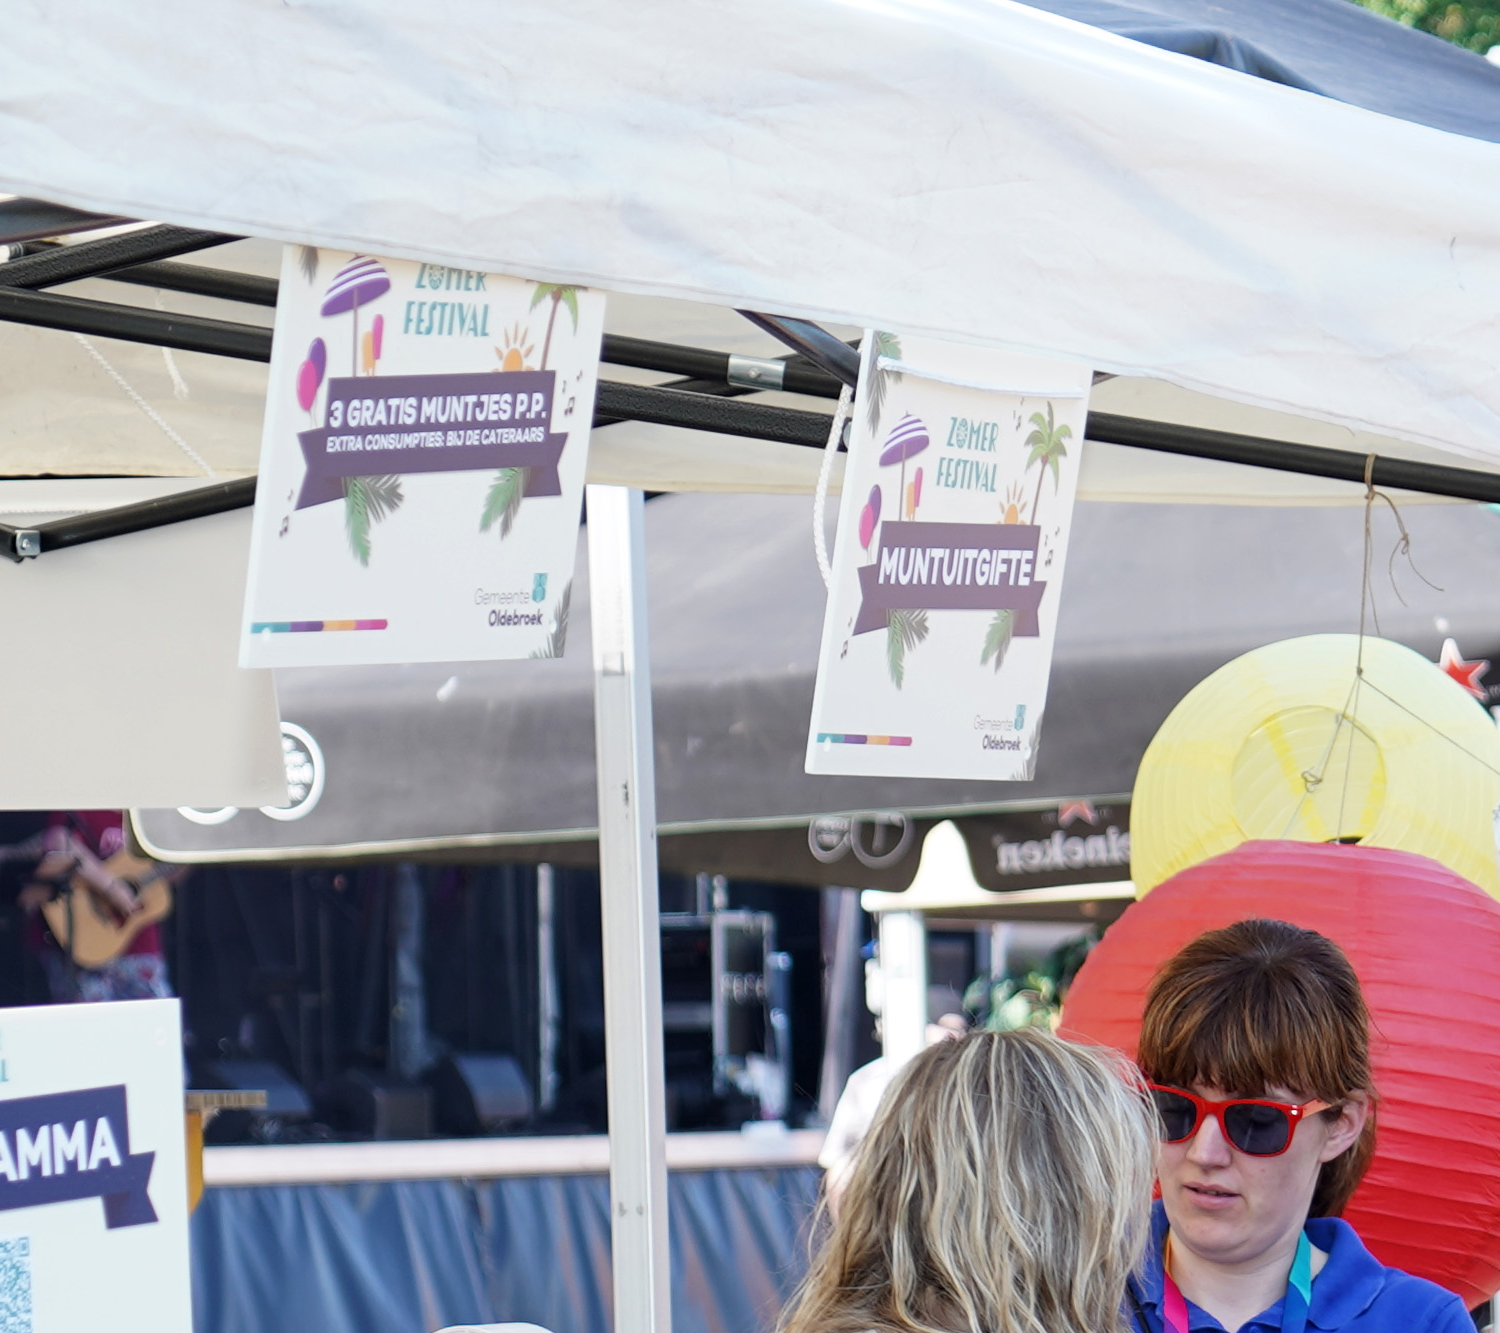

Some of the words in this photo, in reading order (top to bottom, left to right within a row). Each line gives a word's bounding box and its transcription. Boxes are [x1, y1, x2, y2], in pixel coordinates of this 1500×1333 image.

[403, 301, 490, 337] FESTIVAL
[329, 400, 343, 428] 3
[347, 397, 417, 427] GRATIS
[420, 393, 512, 424] MUNTJES
[514, 392, 547, 419] P.P.
[326, 435, 363, 453] EXTRA
[364, 431, 444, 451] CONSUMPTIES:
[446, 430, 464, 447] BIJ
[465, 429, 481, 446] DE
[481, 427, 545, 445] CATERAARS
[946, 416, 997, 453] ZOMER
[936, 457, 998, 493] FESTIVAL
[878, 546, 1034, 587] MUNTUITGIFTE
[474, 587, 531, 606] Gemeente
[488, 609, 543, 627] Oldebroek
[974, 714, 1013, 732] Gemeente
[982, 734, 1021, 752] Oldebroek
